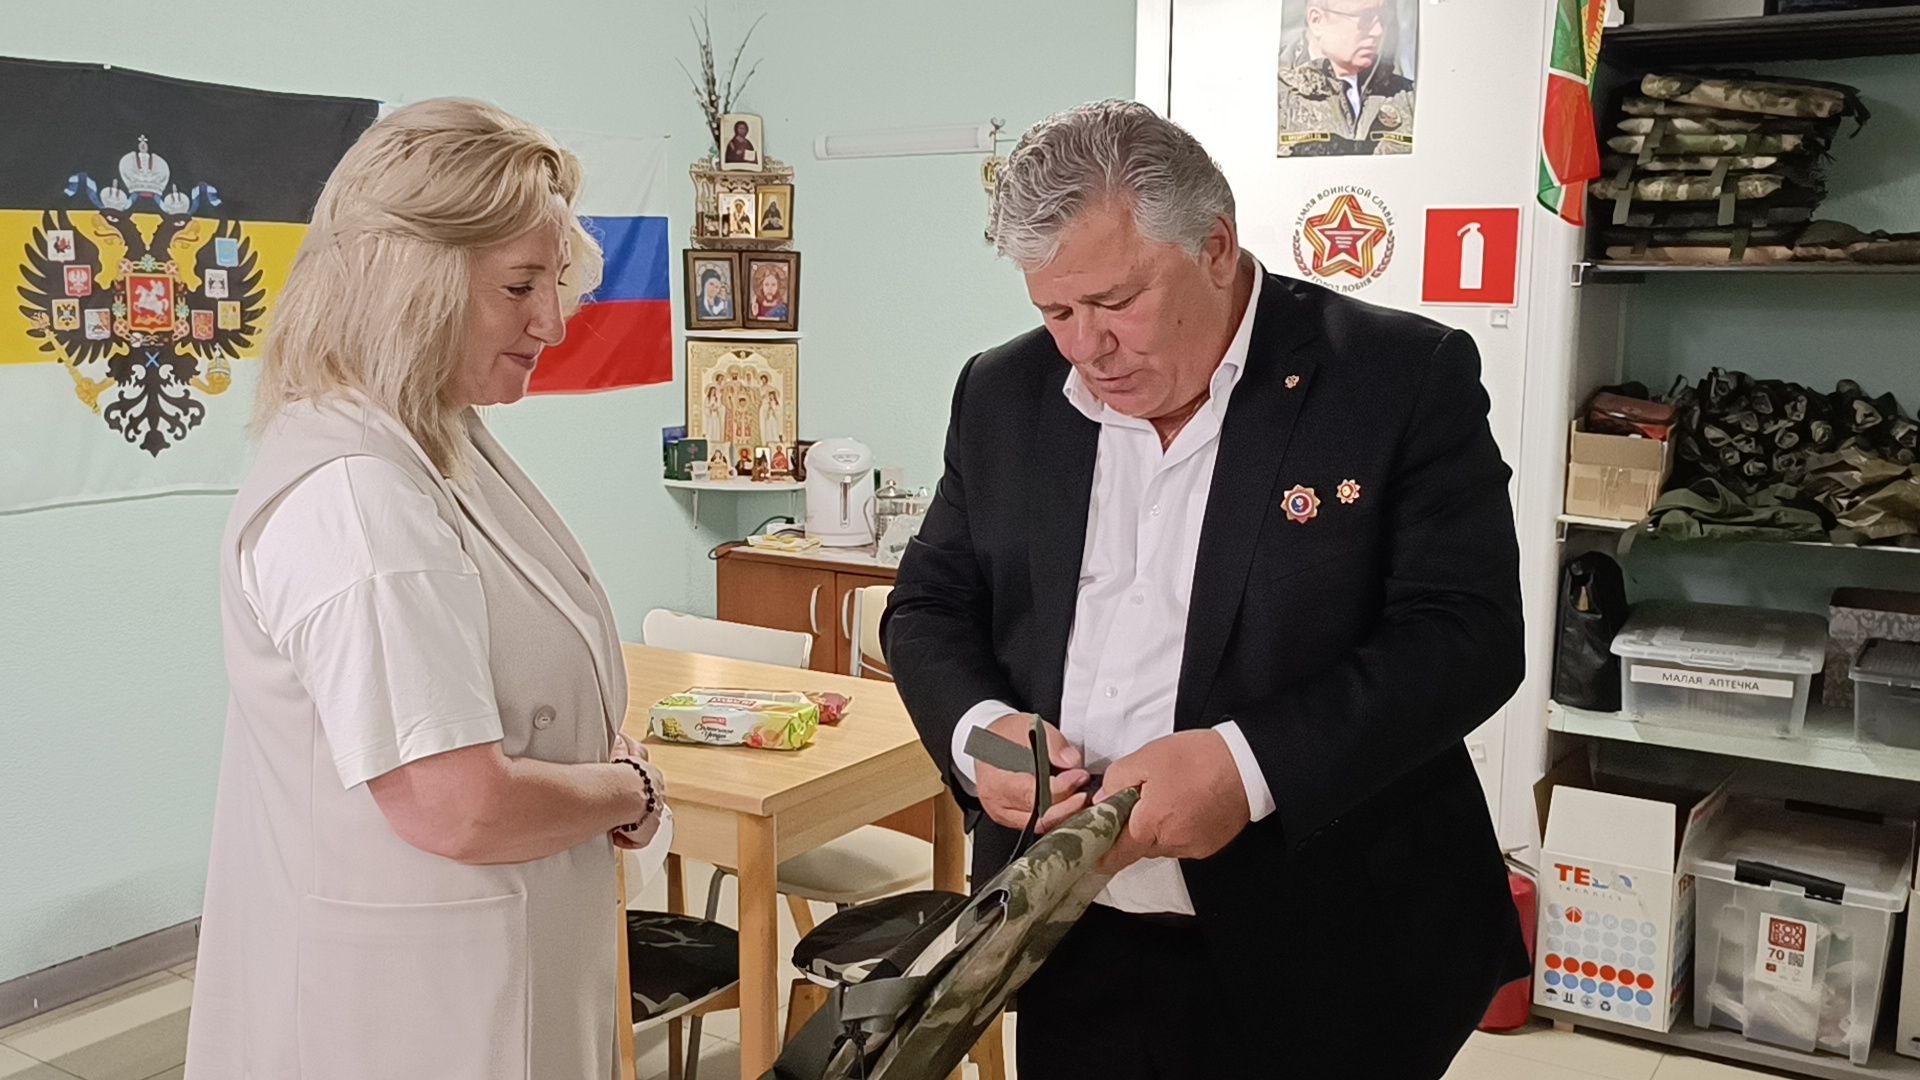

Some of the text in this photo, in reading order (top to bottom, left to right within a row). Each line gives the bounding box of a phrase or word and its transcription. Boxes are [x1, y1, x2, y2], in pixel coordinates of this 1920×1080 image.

[1295, 185, 1395, 226] ЗЕМЛЯ ВОИНСКОЙ СЛАВЫ
[1342, 277, 1373, 292] ЛОБНЯ
[1662, 672, 1760, 691] МАЛАЯ АПТЕЧКА
[1768, 947, 1785, 961] 70
